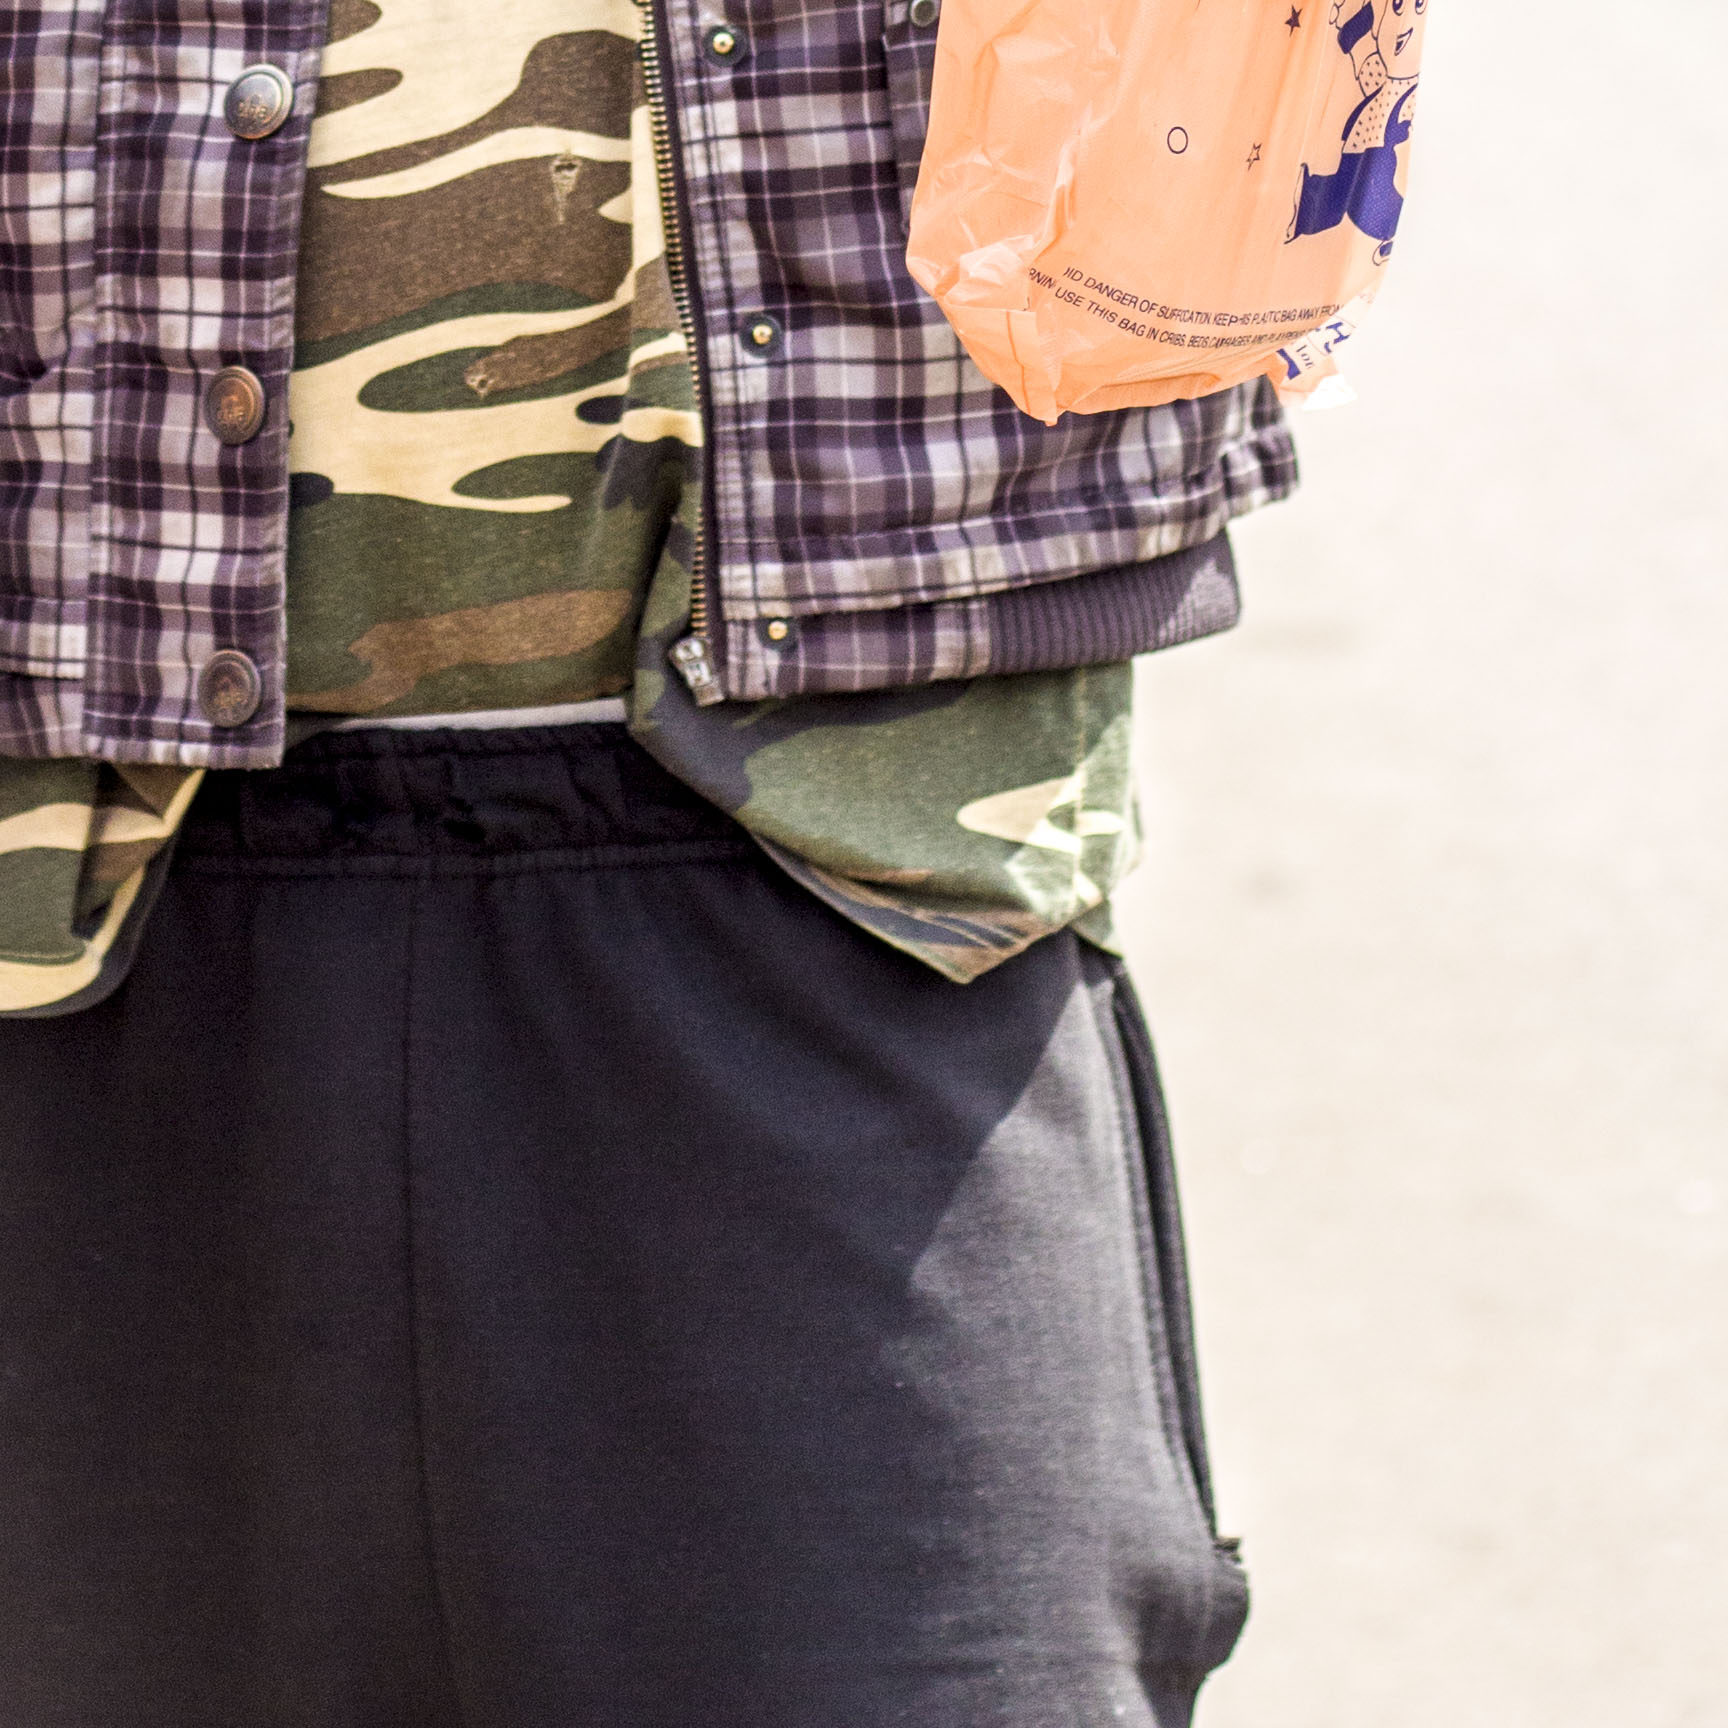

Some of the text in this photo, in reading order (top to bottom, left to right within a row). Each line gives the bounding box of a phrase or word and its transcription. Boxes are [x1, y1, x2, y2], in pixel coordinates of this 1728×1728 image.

[1054, 286, 1086, 308] USE
[1086, 299, 1119, 324] THIS
[1117, 317, 1147, 337] BAG
[1145, 326, 1161, 342] IN
[1083, 276, 1139, 309] DANGER
[1138, 299, 1160, 315] OF
